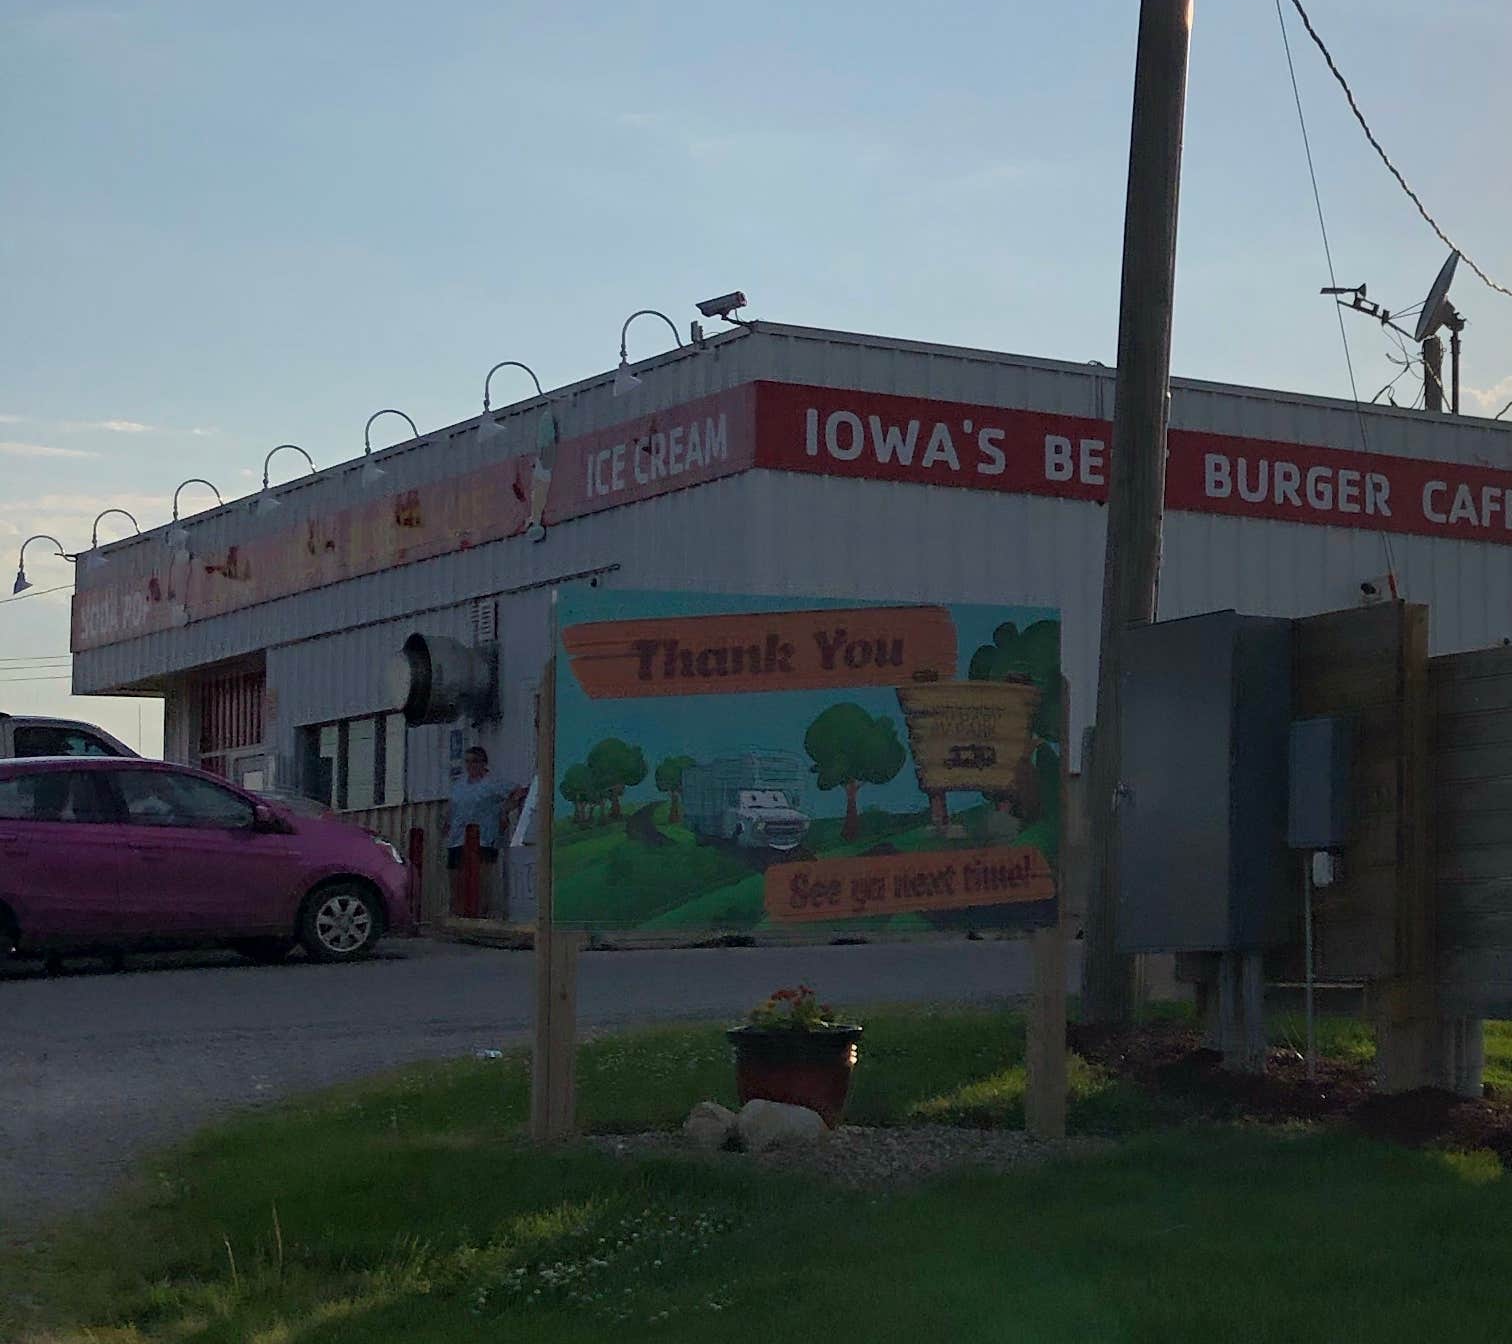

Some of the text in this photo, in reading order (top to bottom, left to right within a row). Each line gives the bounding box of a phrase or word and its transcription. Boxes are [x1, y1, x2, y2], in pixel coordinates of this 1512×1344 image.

[587, 413, 728, 497] ICE CREAM
[806, 408, 1006, 475] IOWA'S
[1205, 453, 1392, 517] BURGER
[633, 628, 904, 681] Thank You
[790, 872, 841, 909] See
